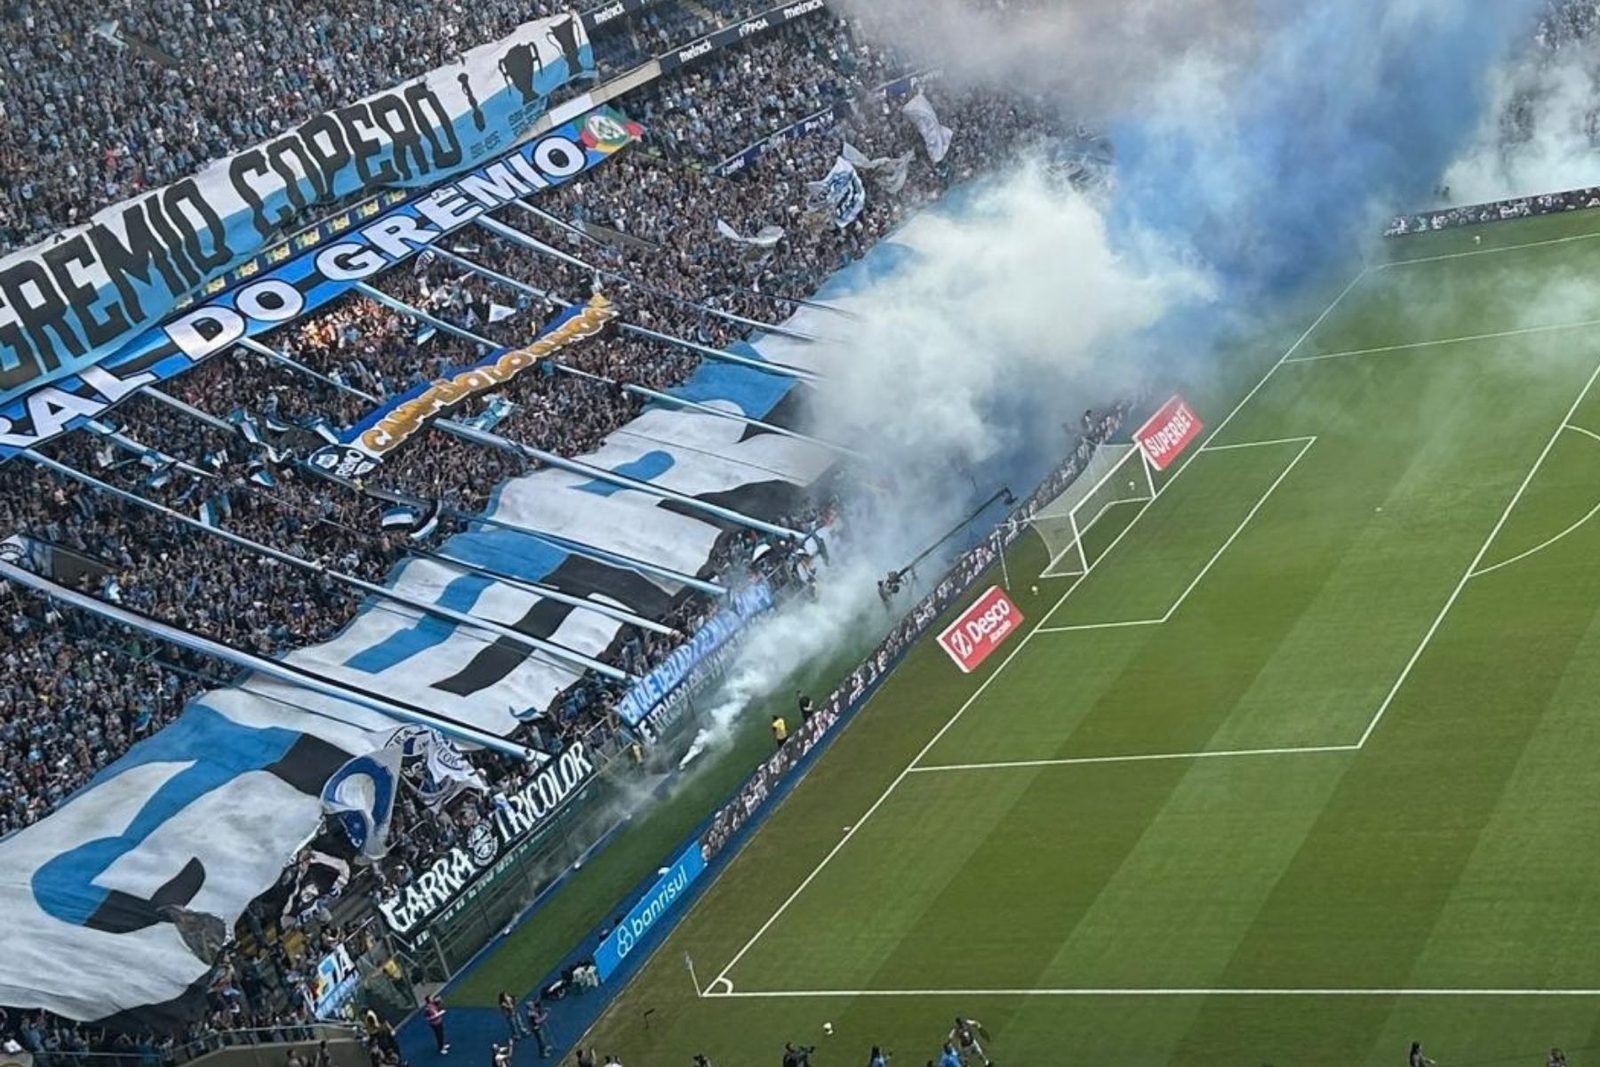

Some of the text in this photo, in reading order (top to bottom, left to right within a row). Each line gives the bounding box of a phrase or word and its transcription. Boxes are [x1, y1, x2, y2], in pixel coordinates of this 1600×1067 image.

[229, 82, 463, 241] COPERO
[163, 280, 303, 362] DO
[316, 137, 585, 281] GRÊMIO
[1144, 404, 1194, 457] SUPERBET
[966, 599, 1010, 644] Desco
[378, 847, 478, 932] GARRA
[492, 741, 592, 843] TRICOLOR
[631, 865, 688, 937] banrisul
